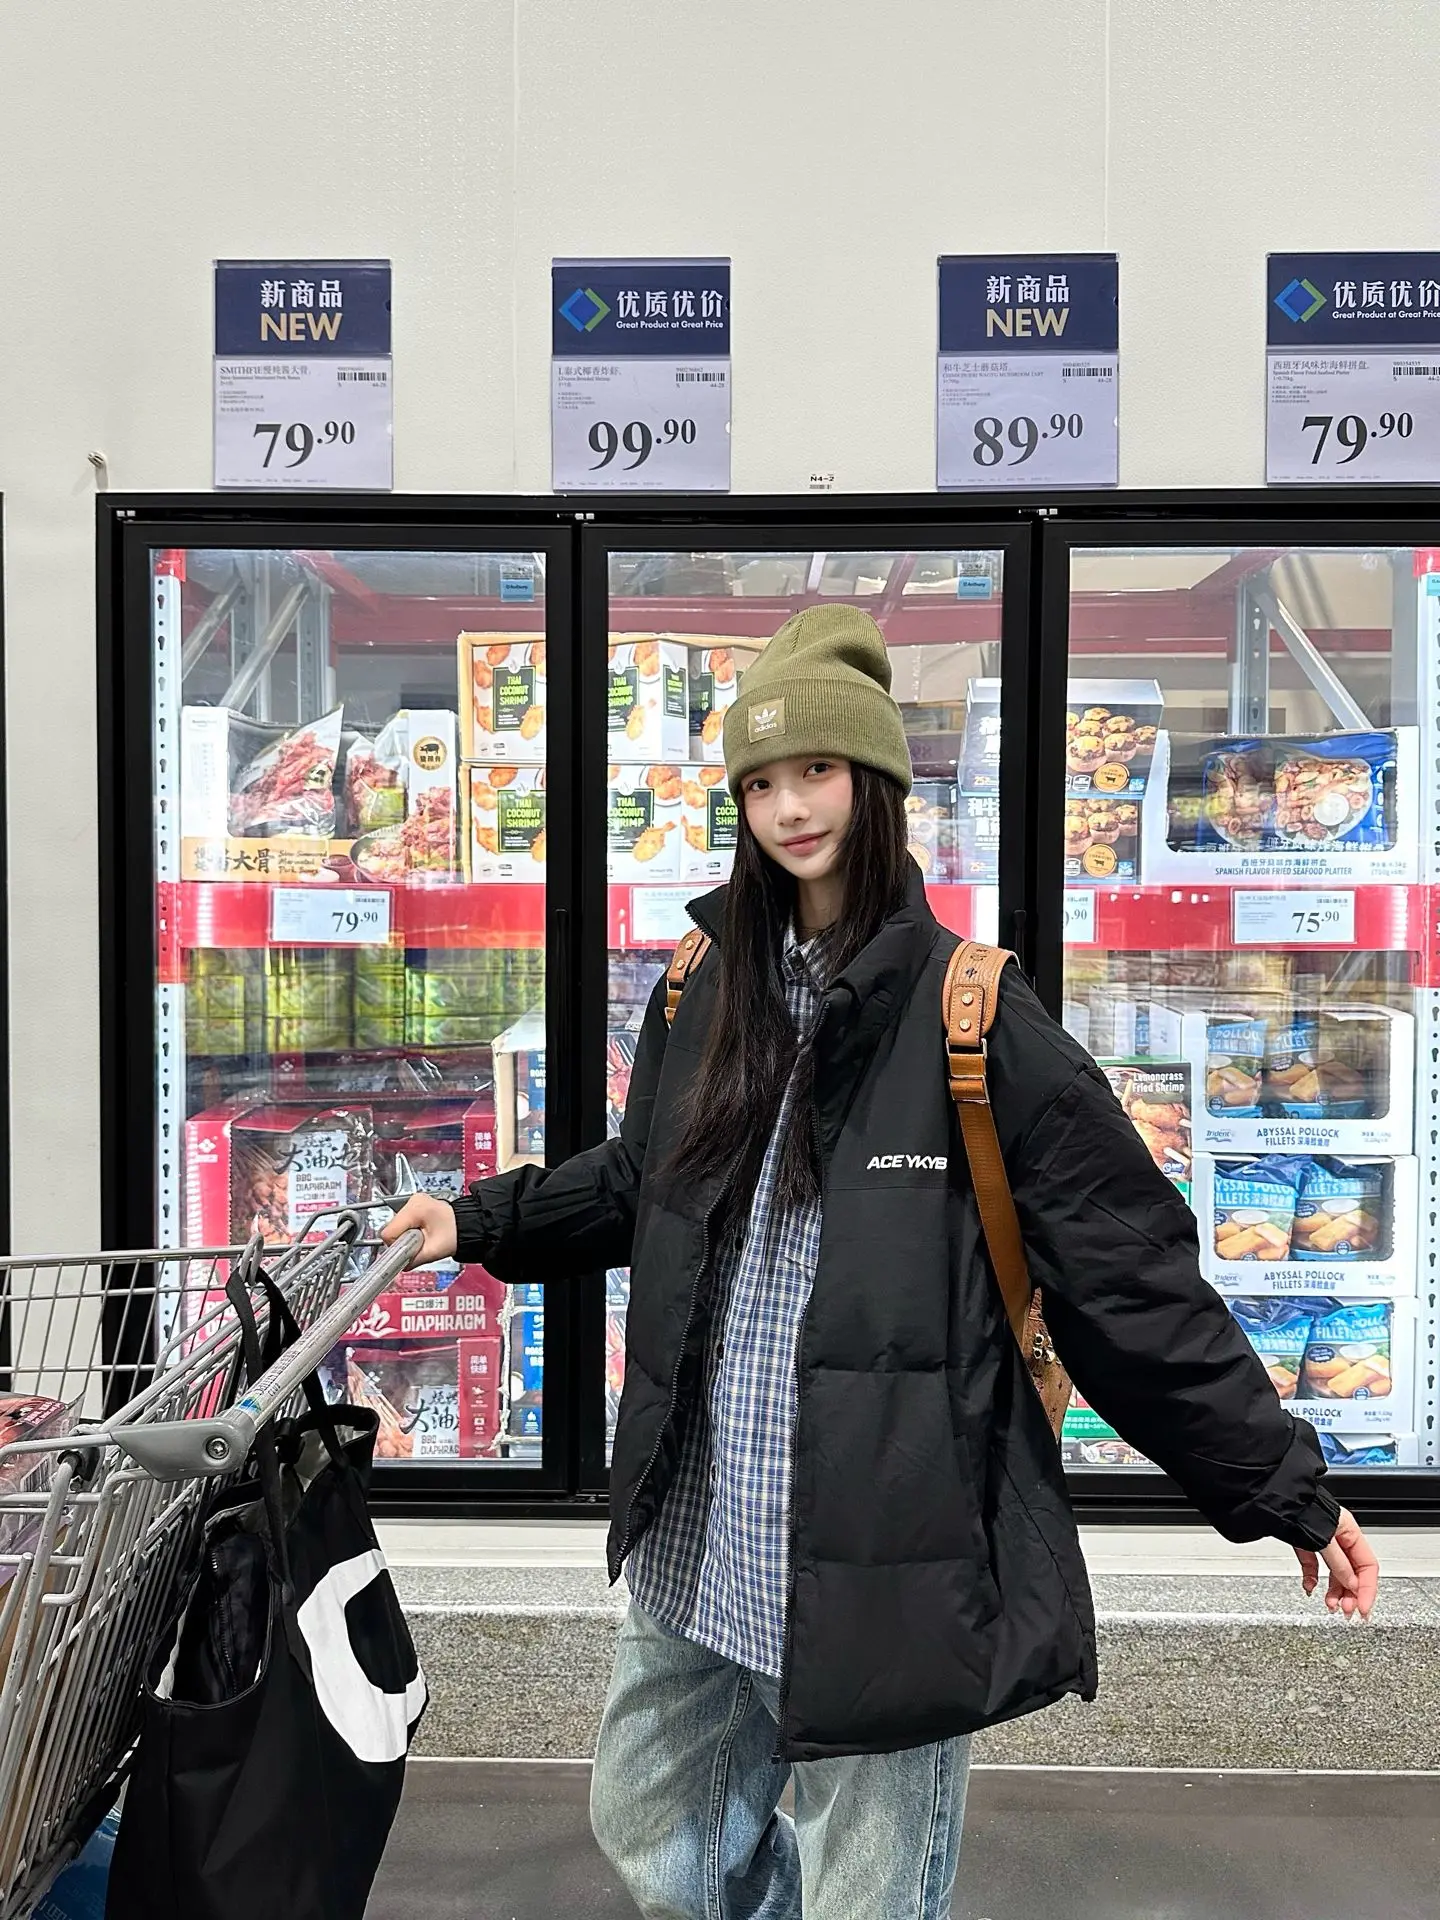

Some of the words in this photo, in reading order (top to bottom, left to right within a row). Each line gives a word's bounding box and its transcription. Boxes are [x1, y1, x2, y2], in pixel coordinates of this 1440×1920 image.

[986, 274, 1069, 303] 新商品
[260, 280, 343, 308] 新商品
[1332, 280, 1440, 308] 优质优价
[616, 290, 724, 318] 优质优价
[1398, 310, 1420, 318] Great
[1423, 310, 1440, 318] Price
[261, 312, 342, 341] NEW
[616, 320, 638, 328] Great
[640, 320, 669, 328] Product
[671, 320, 680, 328] at
[681, 320, 703, 328] Great
[705, 320, 724, 328] Price
[986, 308, 1069, 337] NEW
[973, 414, 1083, 466] 89.90
[1301, 412, 1414, 464] 79.90
[253, 421, 355, 468] 79.90
[588, 419, 696, 470] 99.90
[500, 696, 528, 705] SHRIMP
[754, 722, 778, 732] adidas
[515, 799, 532, 808] THAI
[616, 798, 636, 806] THAI
[506, 808, 541, 818] COCONUT
[506, 819, 541, 828] SHRIMP
[716, 817, 738, 826] SHRI
[1215, 868, 1244, 876] SPANISH
[1245, 868, 1270, 876] FLAVOR
[1272, 868, 1291, 876] FRIED
[1292, 868, 1324, 876] SEAFOOD
[332, 912, 378, 933] 79.90
[1292, 911, 1340, 934] 75.90
[1134, 1072, 1184, 1082] Lemongrass
[1132, 1082, 1154, 1092] Fried
[1156, 1082, 1184, 1092] Shrimp
[1256, 1128, 1296, 1138] ABYSSAL
[1299, 1128, 1340, 1138] POLLOCK
[1266, 1138, 1296, 1146] FILLETS
[296, 1173, 312, 1182] BBQ
[296, 1181, 342, 1192] DIAPHRAGM
[1264, 1271, 1302, 1280] ABYSSAL
[1305, 1271, 1344, 1281] POLLOCK
[1272, 1280, 1302, 1290] FILLETS
[455, 1295, 486, 1311] BBQ
[402, 1314, 486, 1332] DIAPHRAGM
[1302, 1408, 1342, 1418] POLLOCK
[422, 1435, 436, 1444] BBQ
